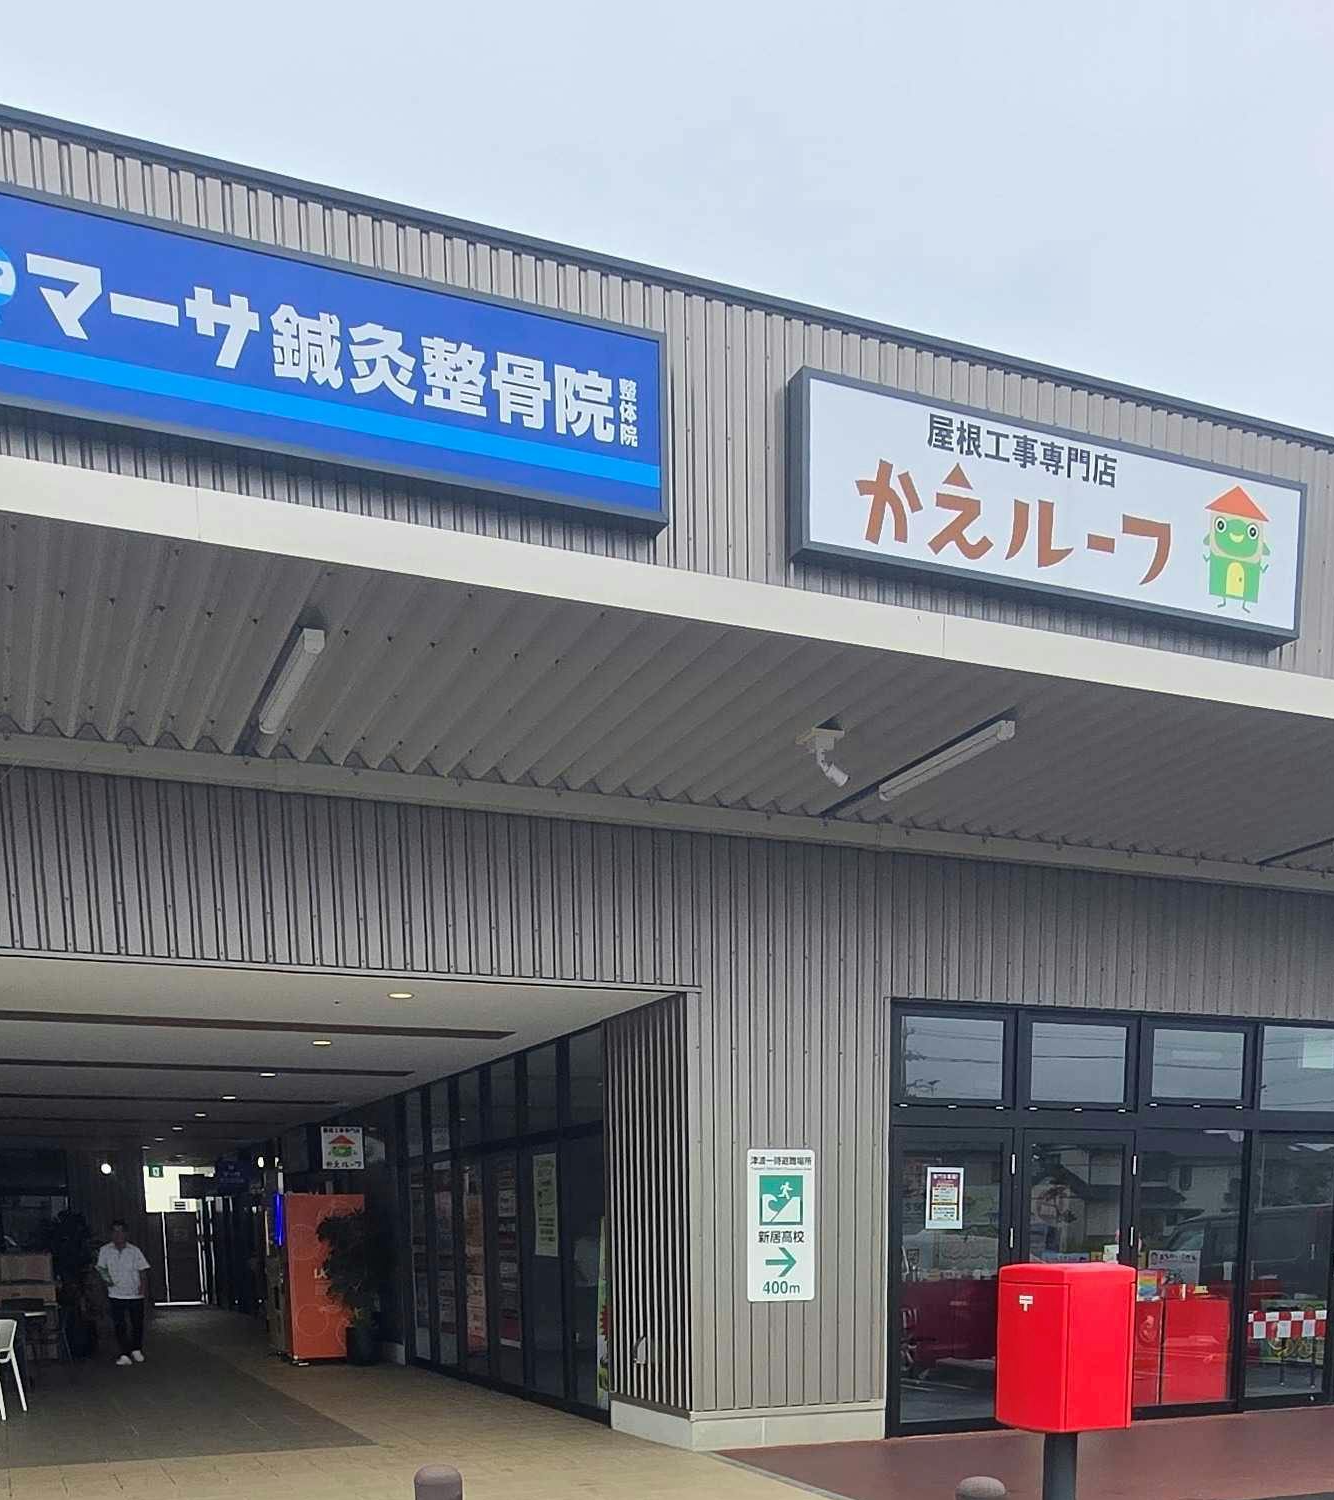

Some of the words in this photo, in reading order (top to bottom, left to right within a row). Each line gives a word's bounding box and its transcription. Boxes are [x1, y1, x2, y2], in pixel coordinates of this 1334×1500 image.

[25, 253, 615, 443] マーサ鍼灸整骨院
[619, 377, 638, 447] 整体院
[927, 413, 1118, 488] 屋根工事専門店
[856, 459, 1172, 585] かえルーフ
[758, 1231, 805, 1243] 新居高校
[763, 1281, 800, 1295] 400m
